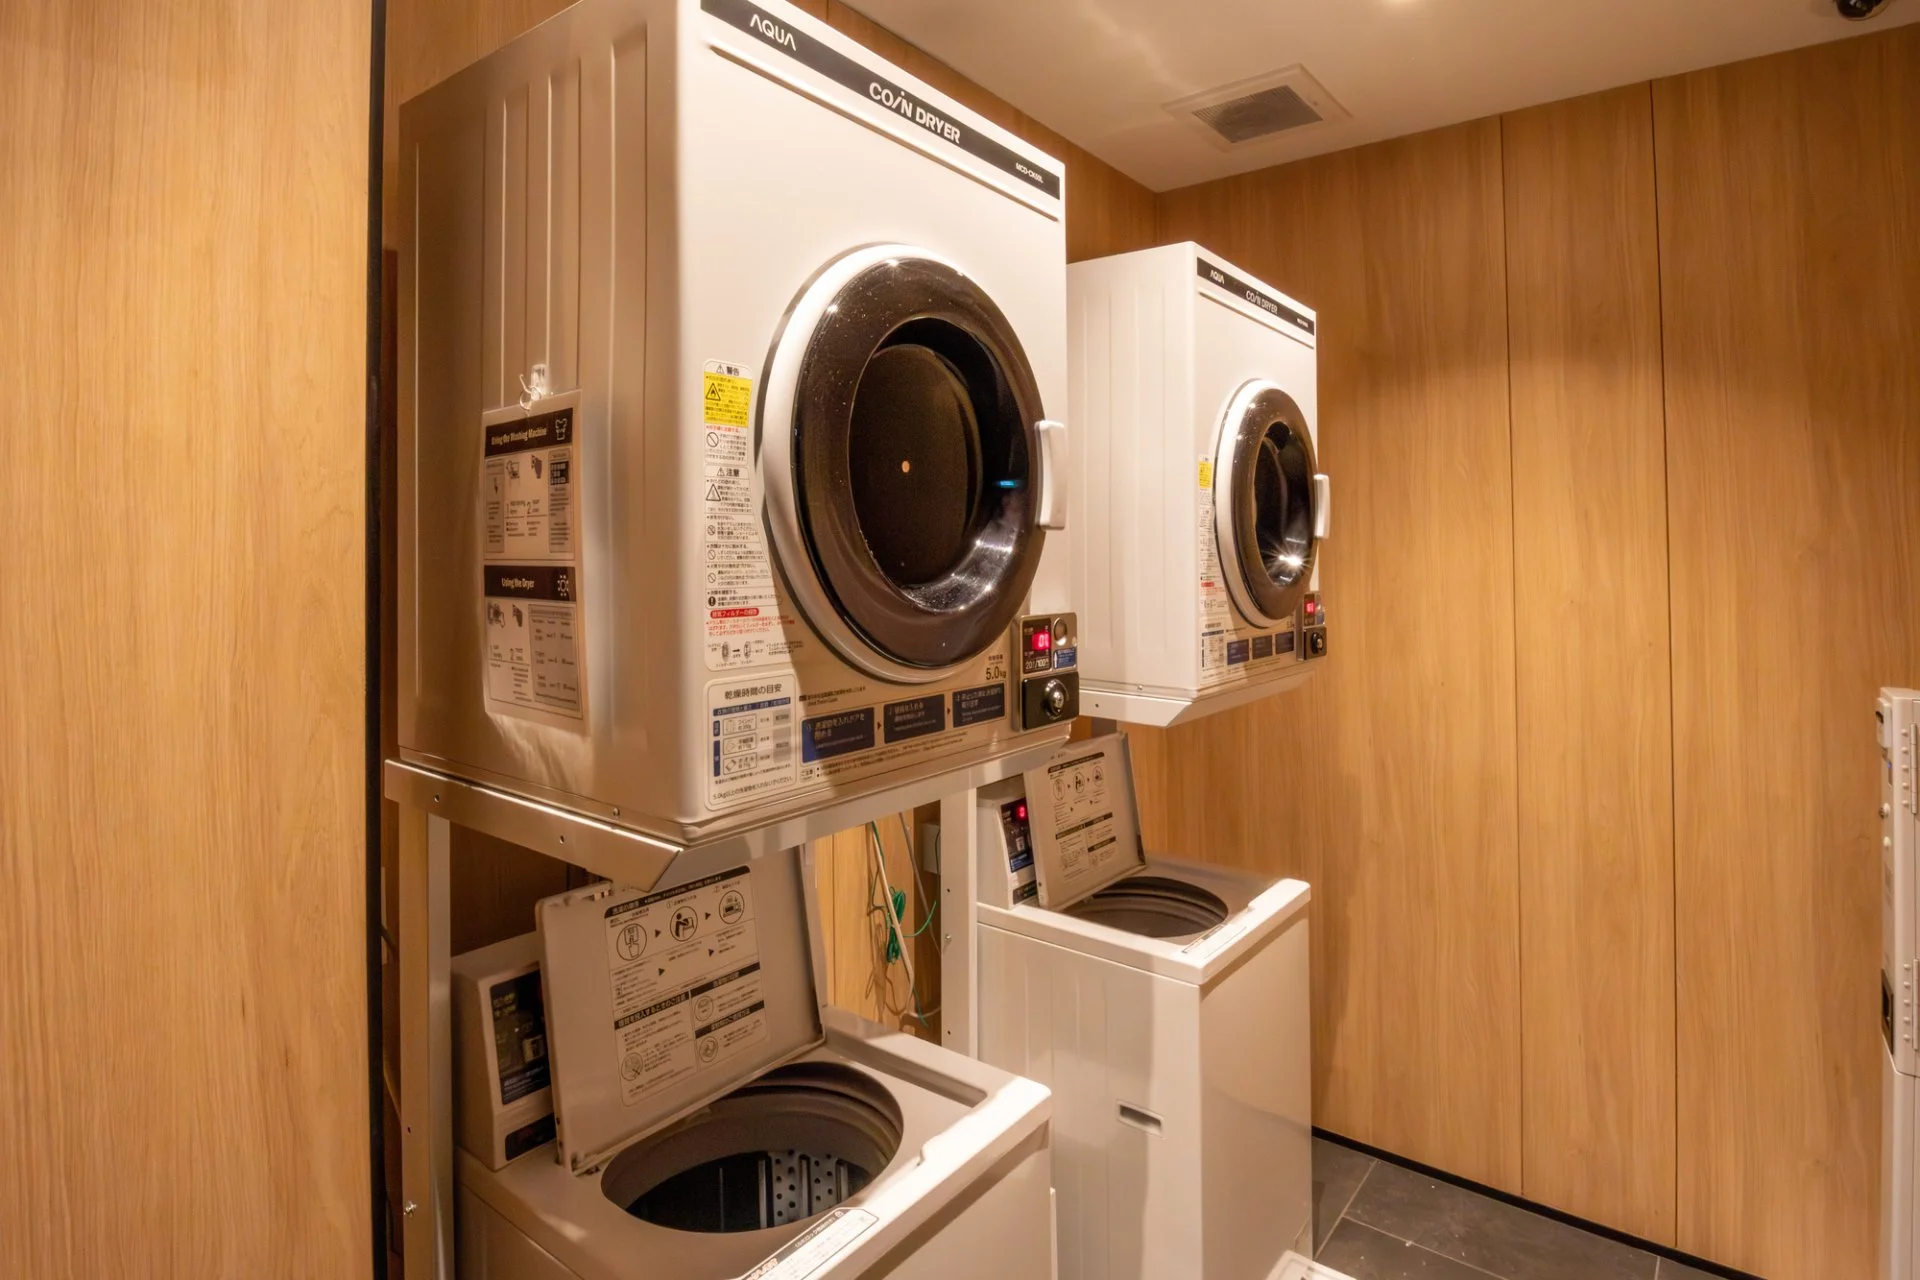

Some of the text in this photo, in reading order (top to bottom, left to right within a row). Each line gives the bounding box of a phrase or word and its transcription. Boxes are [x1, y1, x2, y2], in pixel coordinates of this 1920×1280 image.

[749, 13, 797, 52] AQUA
[869, 82, 960, 145] COIN DRYER
[1210, 269, 1225, 285] AQUA
